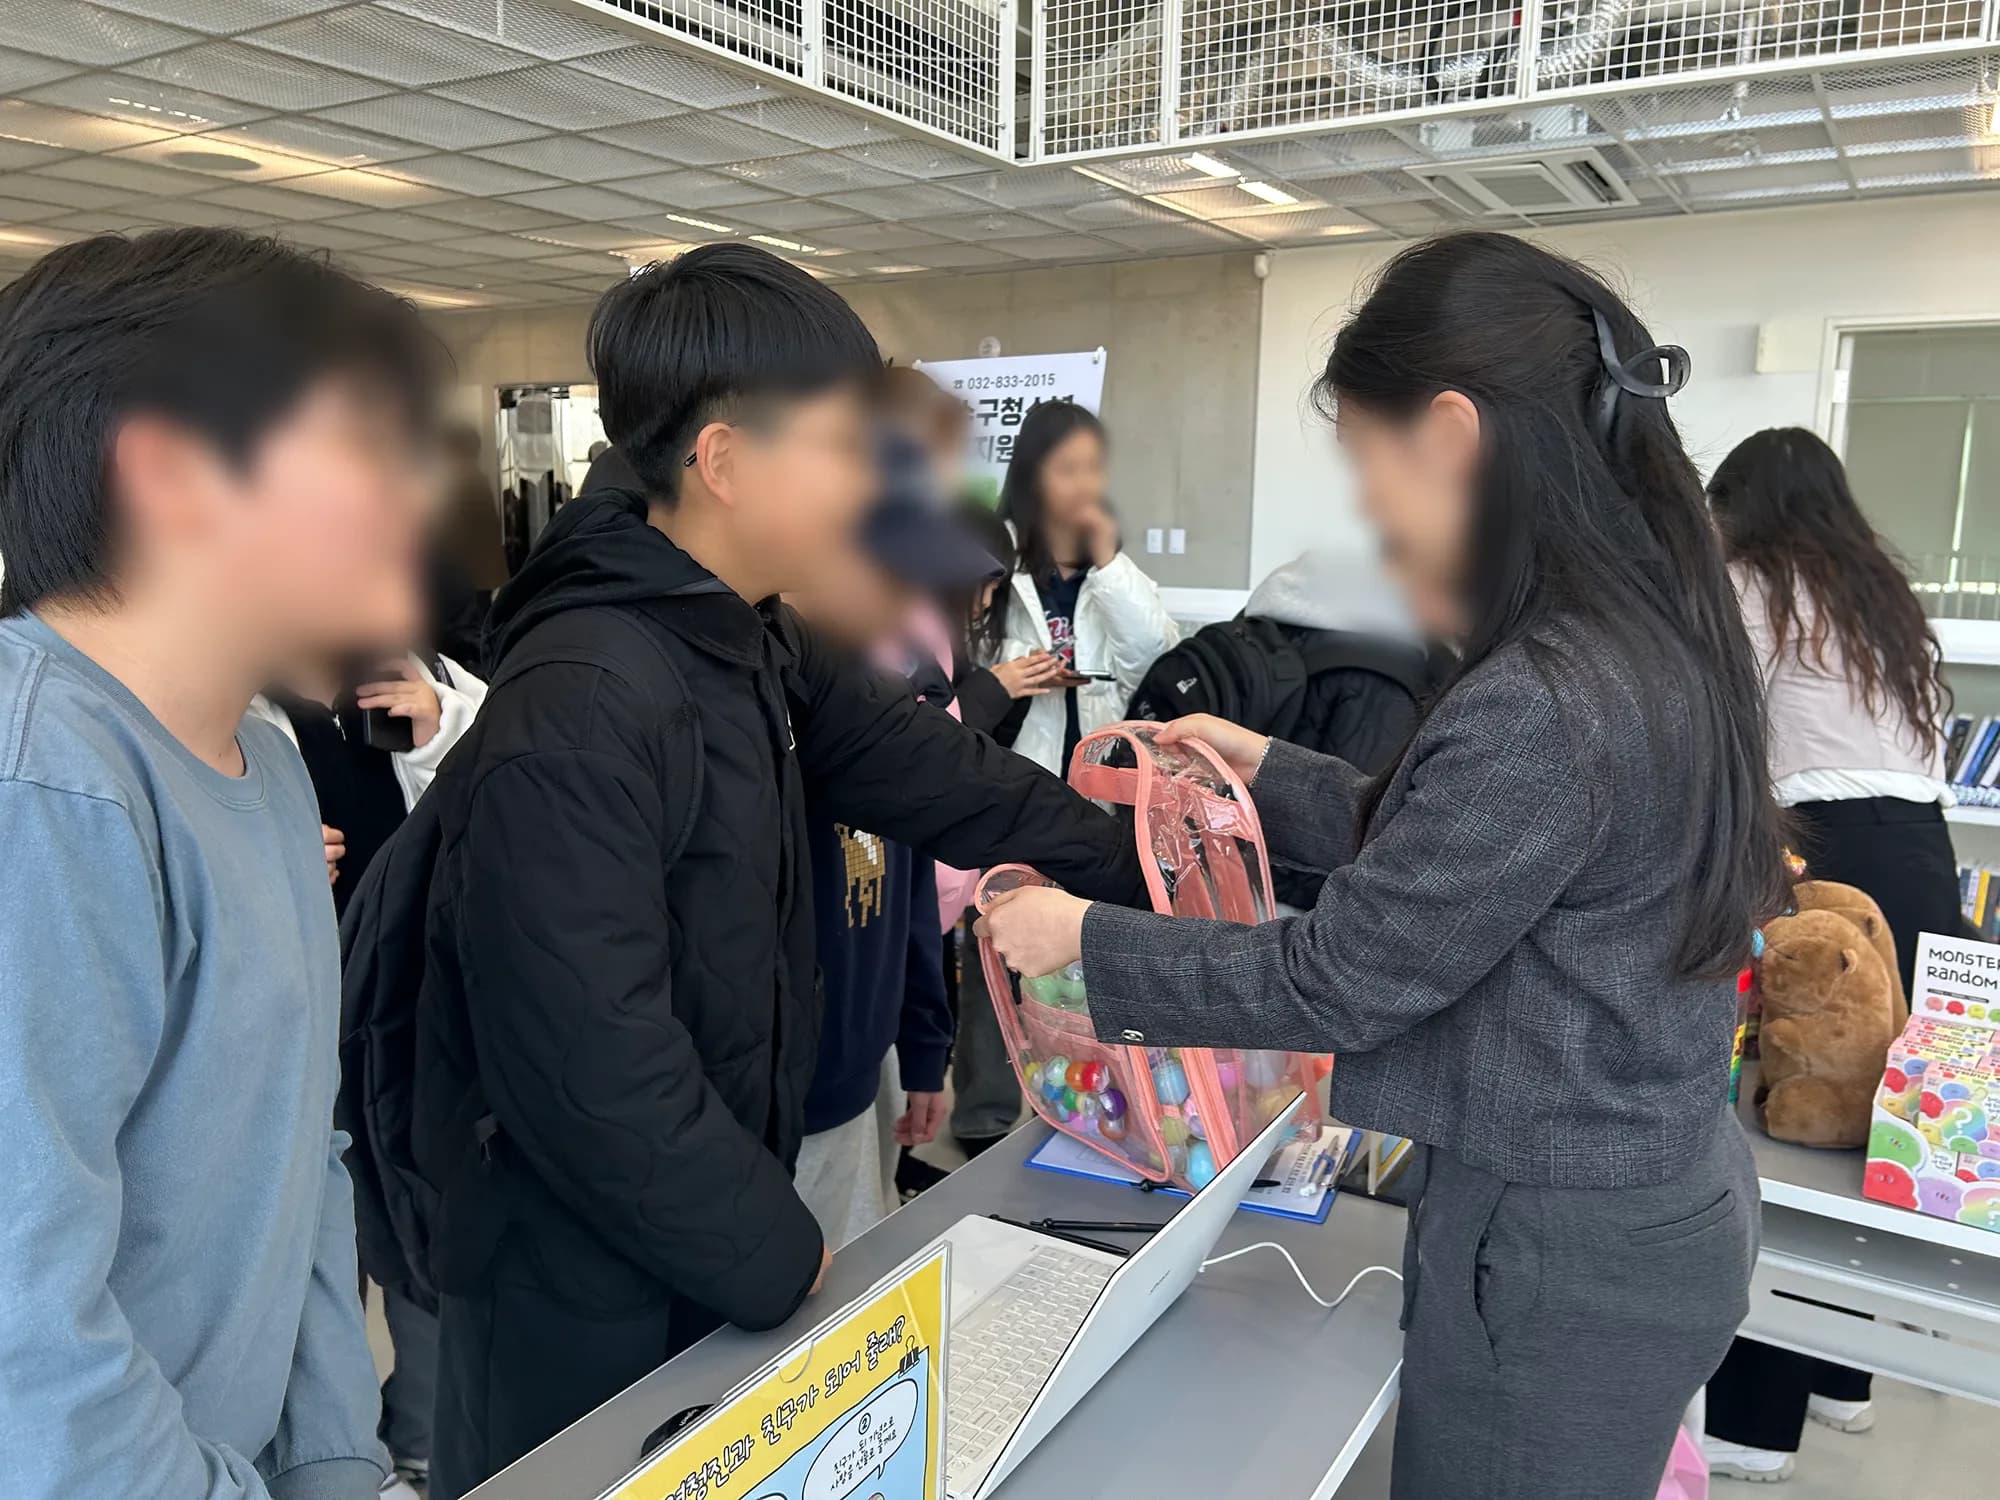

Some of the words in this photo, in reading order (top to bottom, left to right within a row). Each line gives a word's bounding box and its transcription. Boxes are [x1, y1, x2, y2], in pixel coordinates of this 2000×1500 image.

[967, 373, 1056, 390] 032-833-2015
[761, 1384, 820, 1446] 친구가
[825, 1351, 861, 1398] 되어
[866, 1315, 906, 1371] 줄래?
[834, 1449, 856, 1474] 친구가
